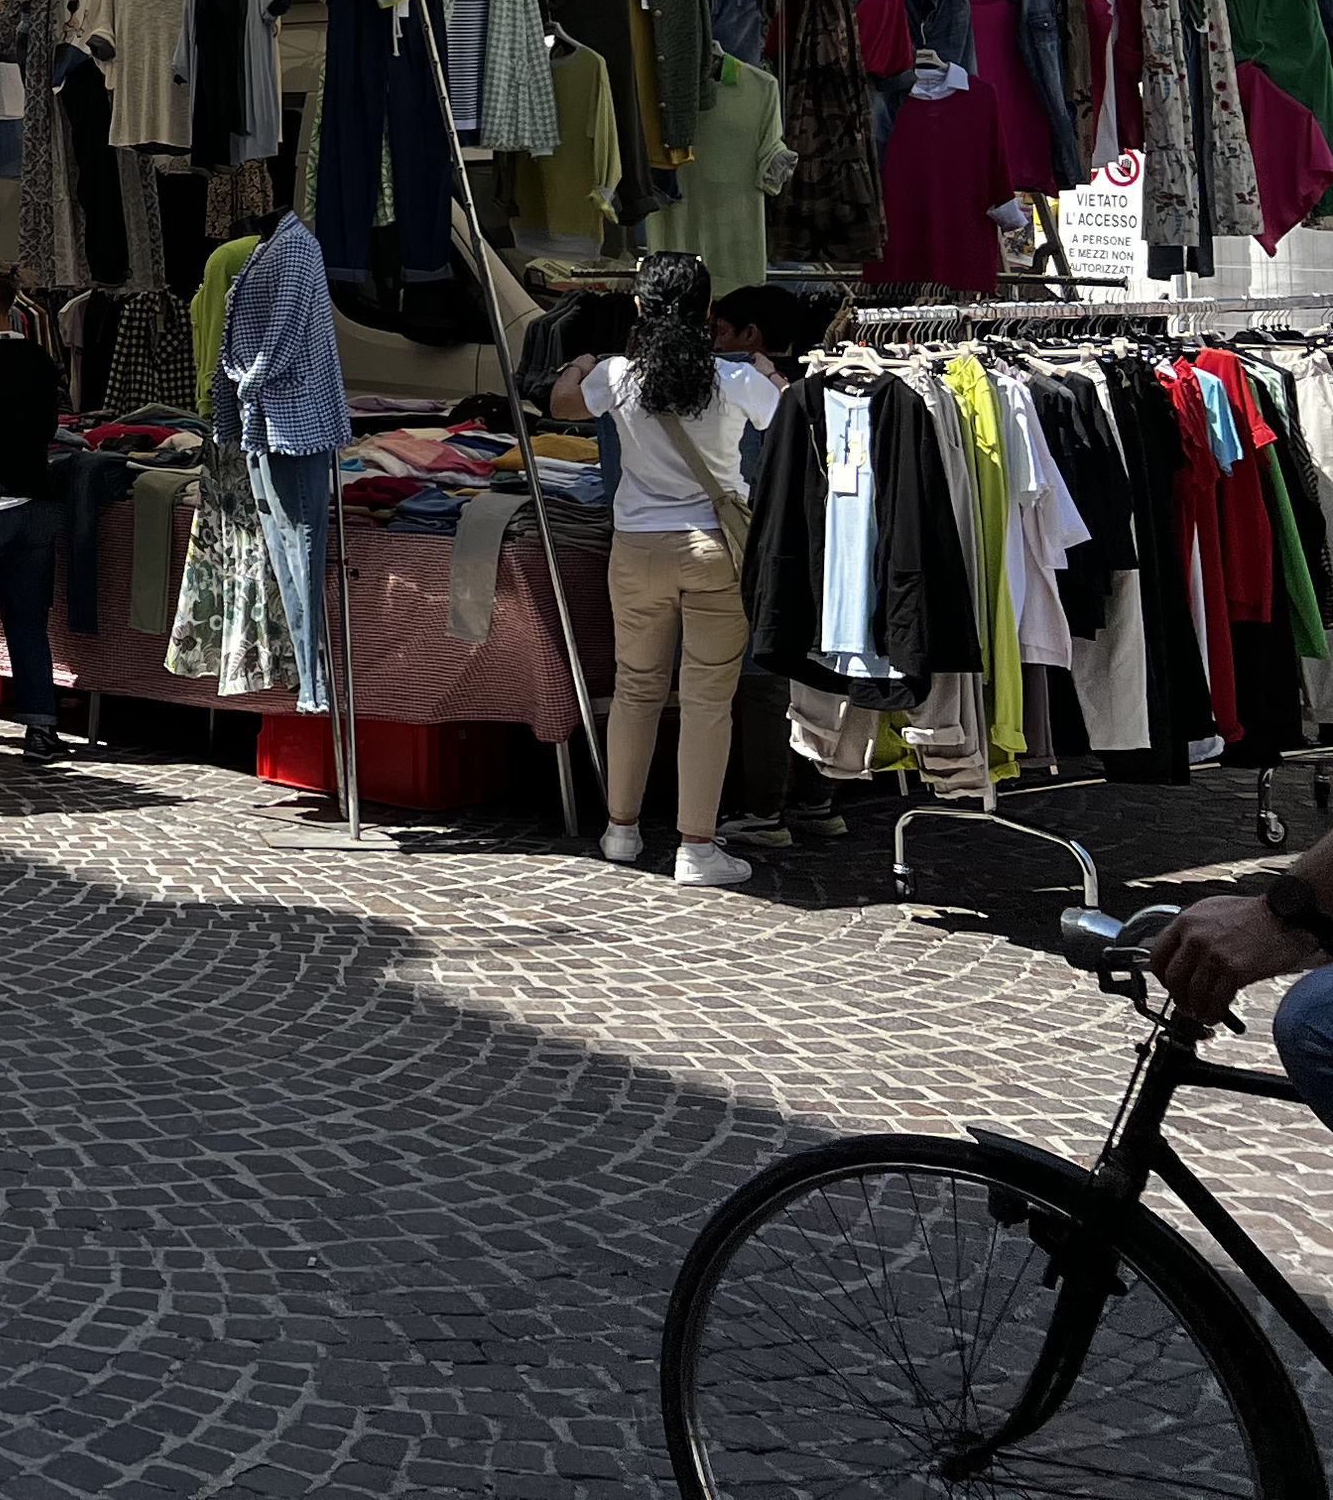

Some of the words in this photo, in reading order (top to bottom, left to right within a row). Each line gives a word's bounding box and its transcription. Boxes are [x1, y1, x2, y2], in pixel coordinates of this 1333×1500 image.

[1076, 193, 1128, 209] VIETATO
[1072, 234, 1079, 244] A
[1082, 234, 1132, 247] PERSONE
[1069, 247, 1075, 258] E
[1078, 248, 1109, 260] MEZZI
[1112, 251, 1134, 261] NON
